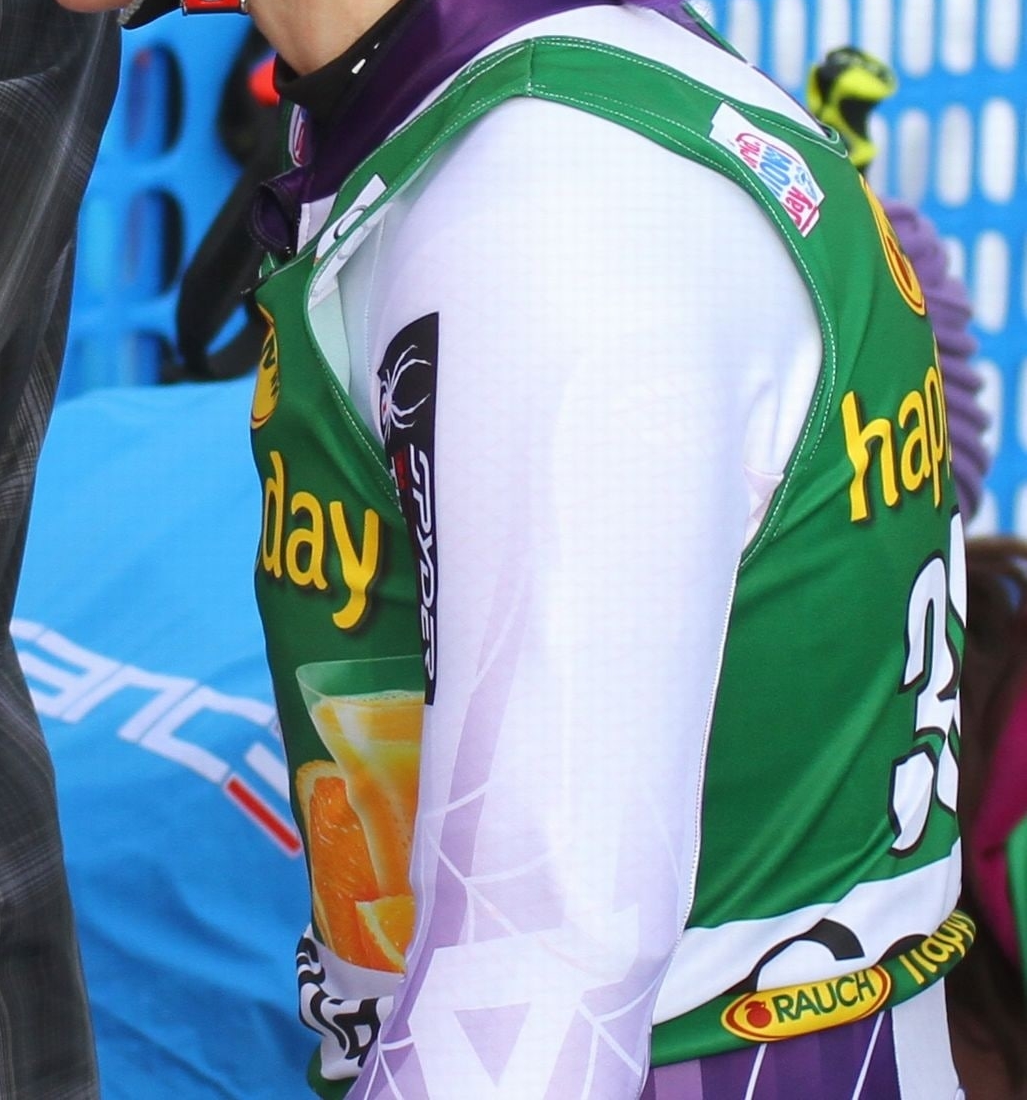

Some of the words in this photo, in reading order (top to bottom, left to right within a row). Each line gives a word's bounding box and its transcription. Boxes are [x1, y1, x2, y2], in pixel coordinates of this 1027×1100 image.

[842, 332, 952, 521] hap
[262, 451, 379, 629] day
[409, 443, 438, 681] SPYDER
[772, 970, 876, 1023] RAUCH
